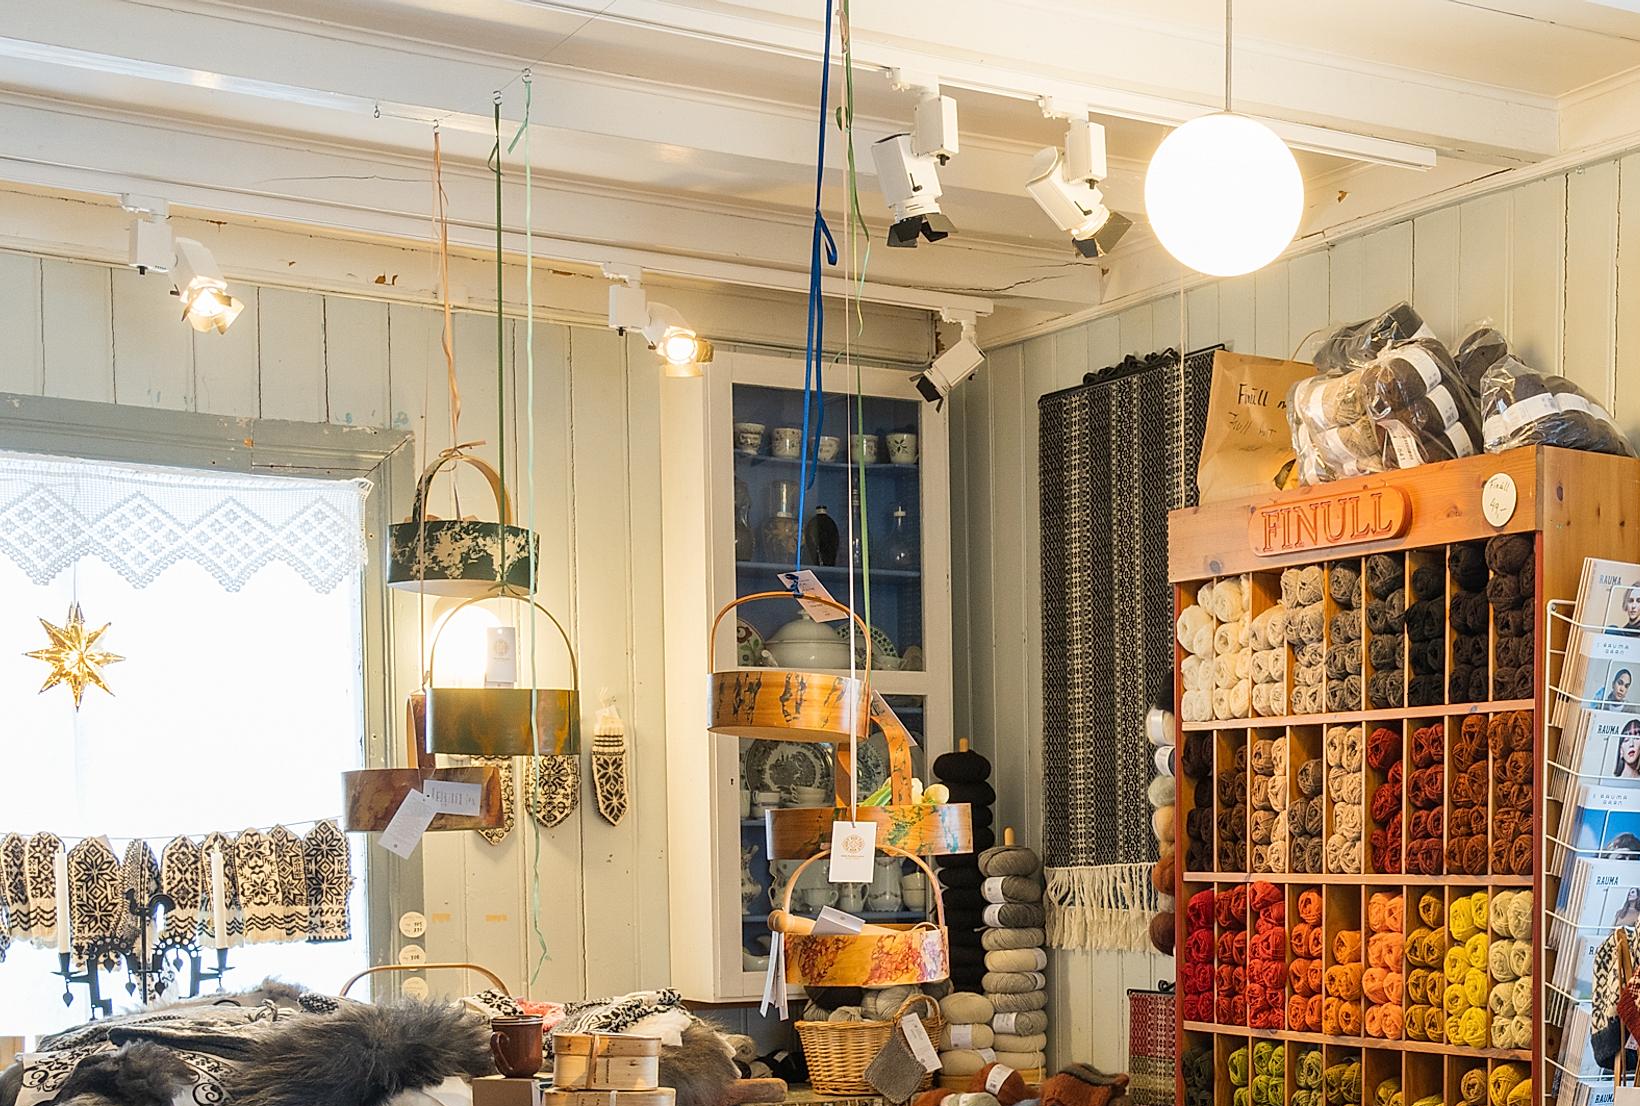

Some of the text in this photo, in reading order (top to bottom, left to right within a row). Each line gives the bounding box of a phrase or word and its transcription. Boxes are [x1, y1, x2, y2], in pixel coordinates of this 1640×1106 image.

[1261, 492, 1393, 553] FINULL
[1599, 574, 1622, 586] RAUMA
[1597, 724, 1620, 735] RAUMA
[1595, 875, 1619, 886] RAUMA
